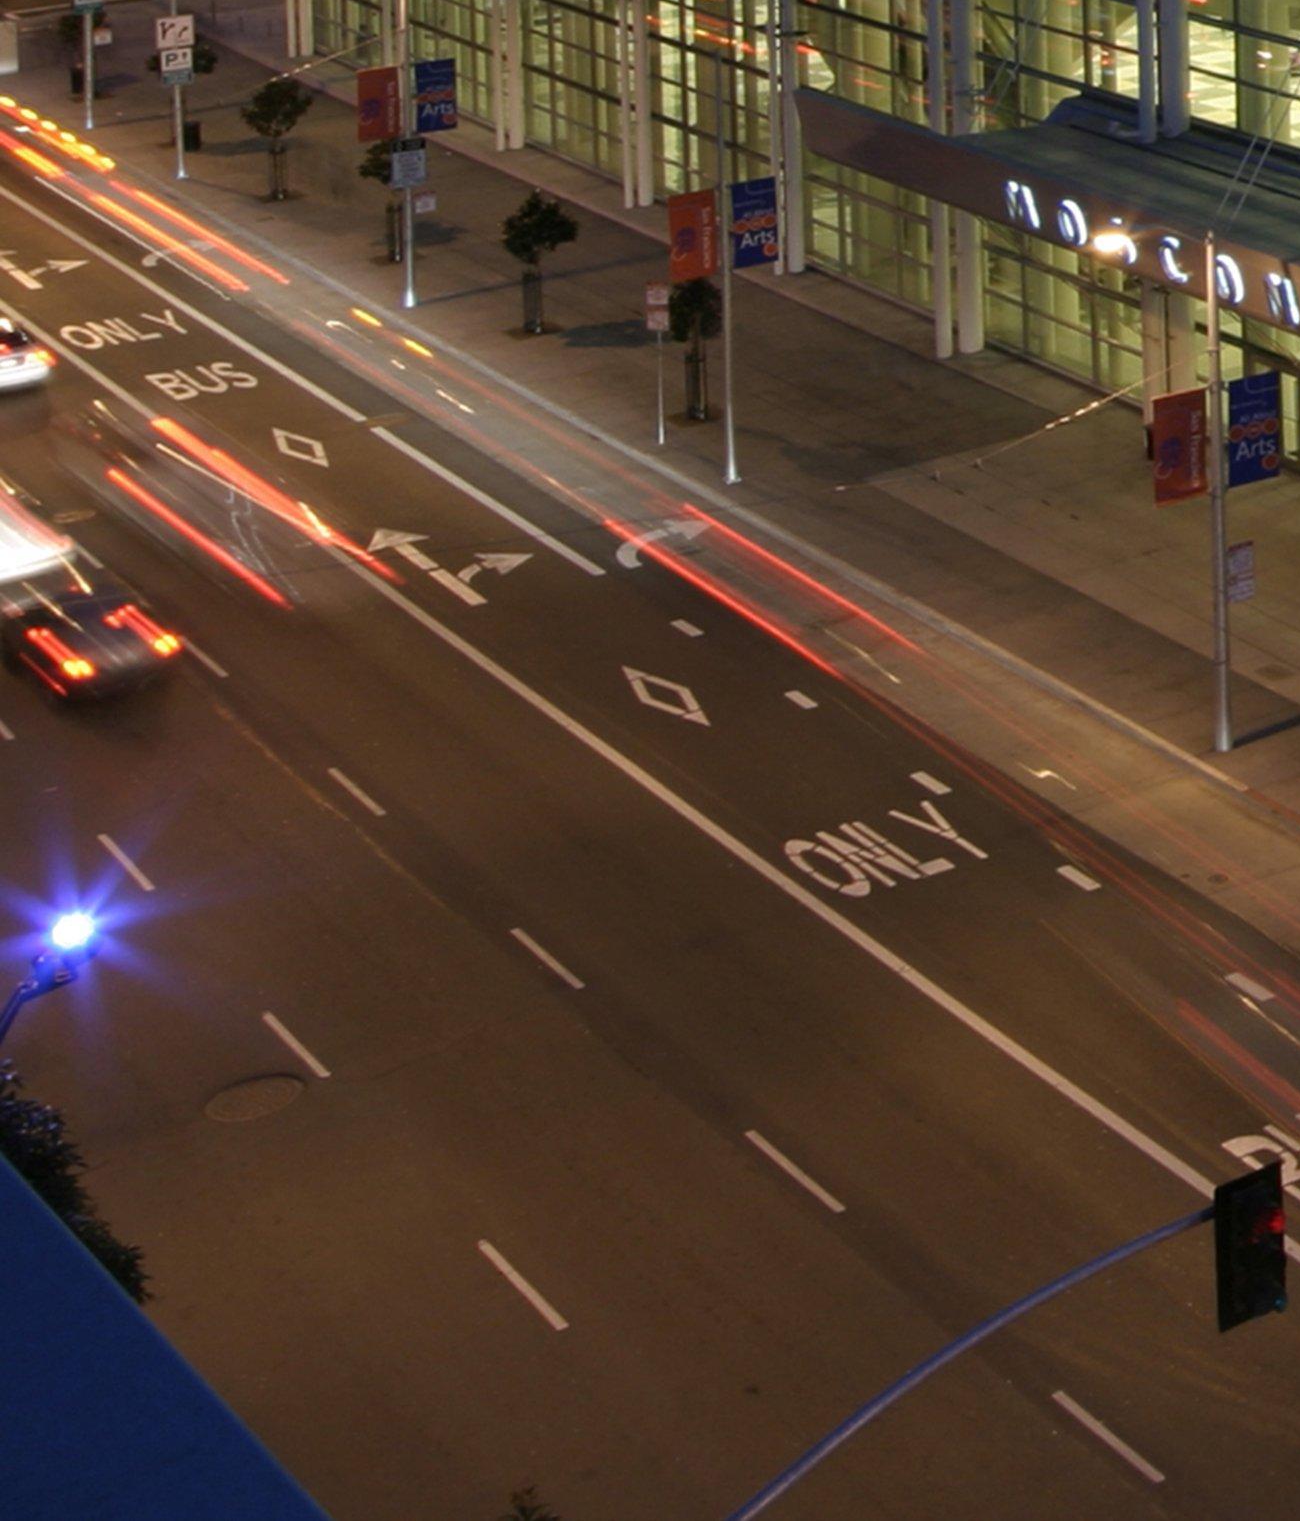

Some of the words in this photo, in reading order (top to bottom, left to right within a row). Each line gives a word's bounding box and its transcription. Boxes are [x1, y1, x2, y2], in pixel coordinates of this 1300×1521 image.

[165, 52, 178, 68] P
[421, 102, 455, 118] Arts
[740, 229, 775, 249] Arts
[60, 309, 187, 350] ONLY
[145, 362, 258, 401] BUS
[1235, 438, 1276, 461] Arts
[784, 800, 988, 897] ONLY
